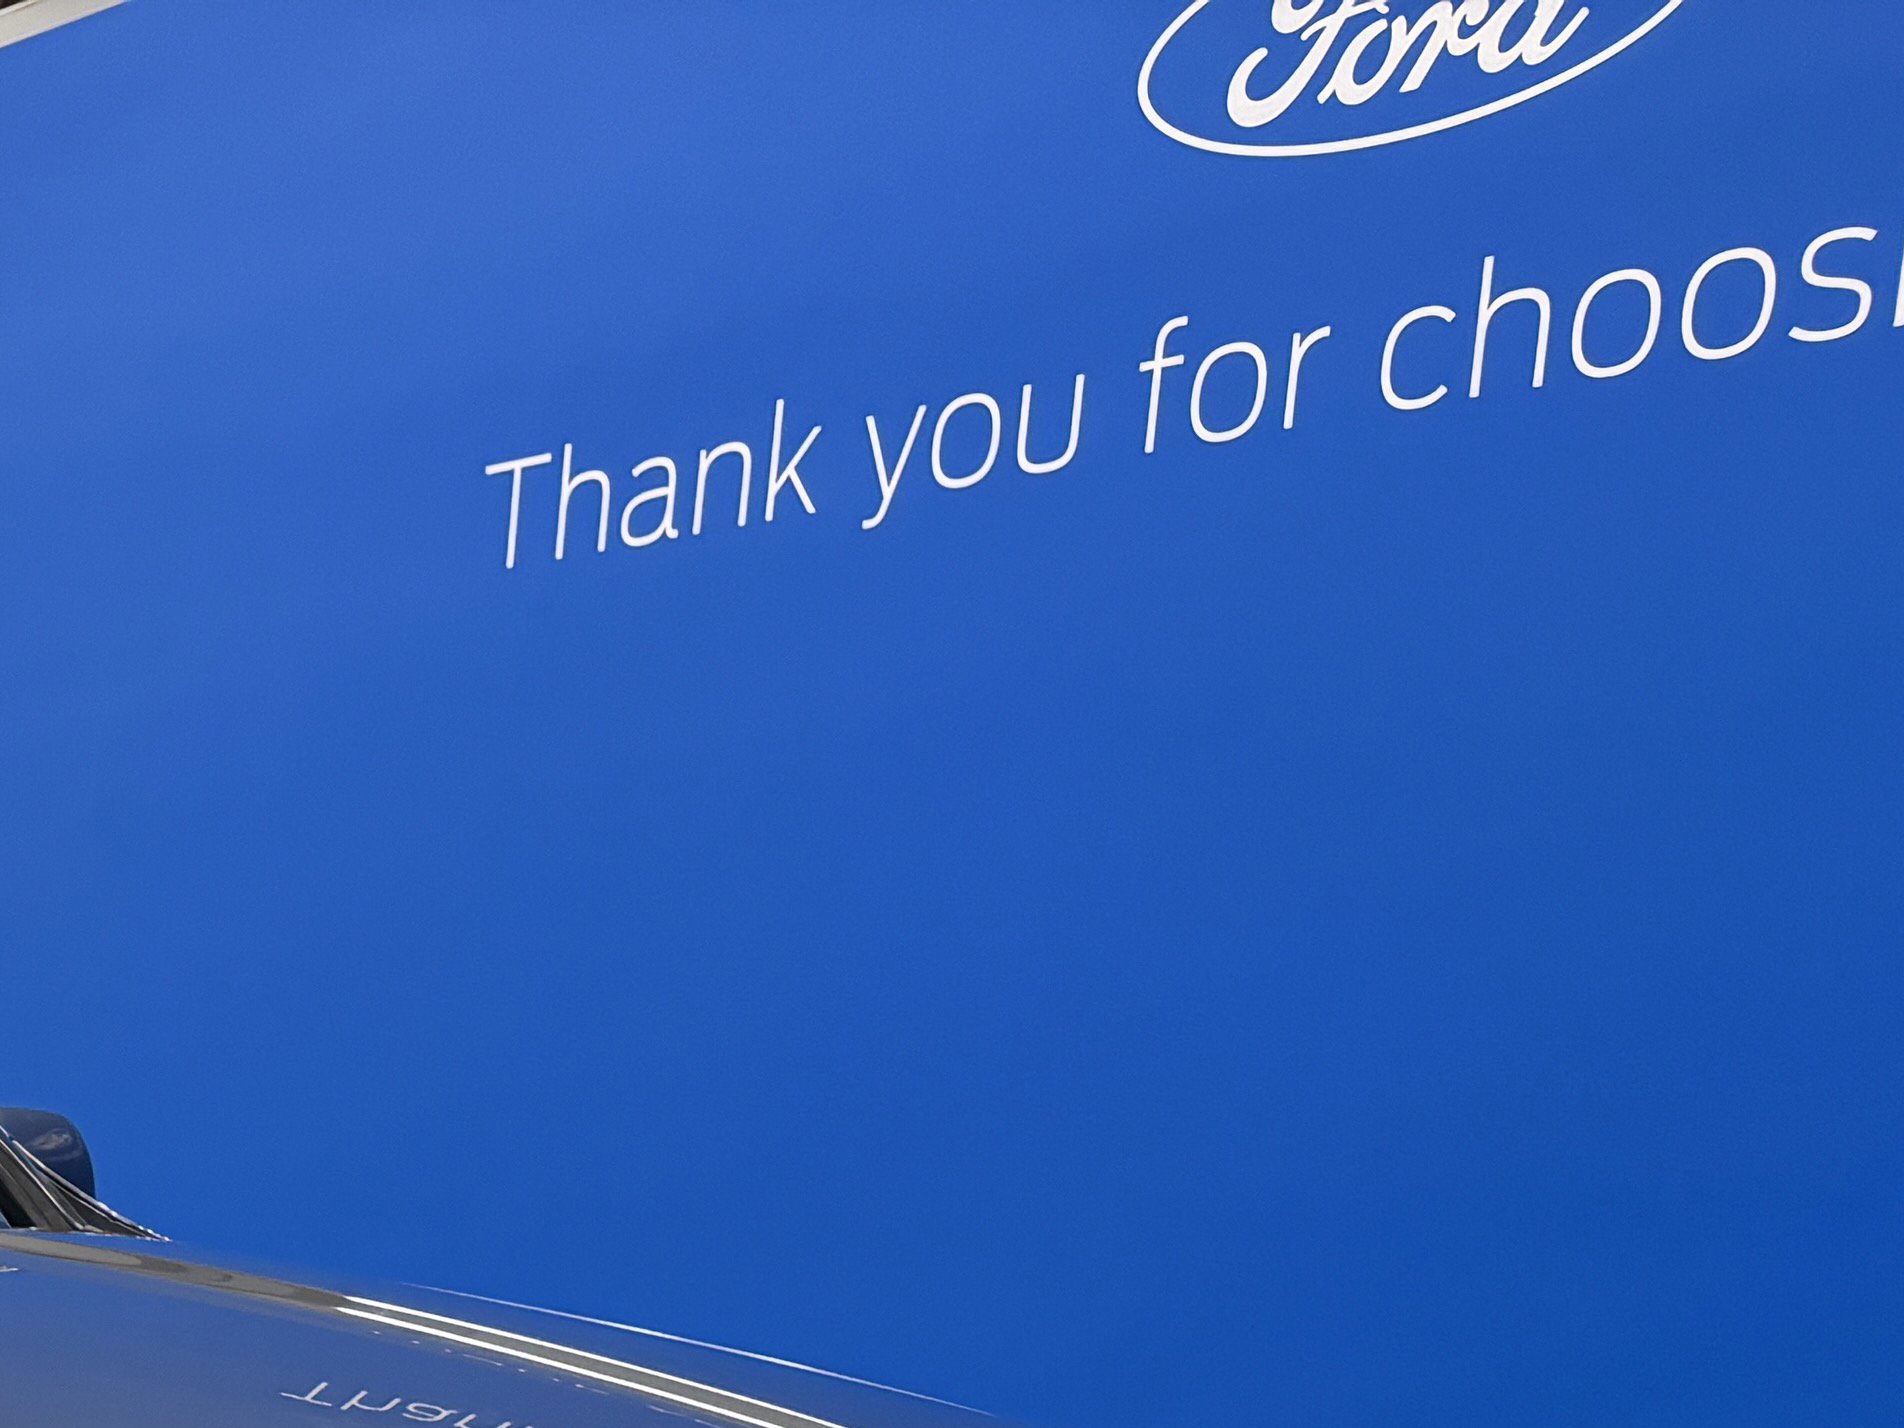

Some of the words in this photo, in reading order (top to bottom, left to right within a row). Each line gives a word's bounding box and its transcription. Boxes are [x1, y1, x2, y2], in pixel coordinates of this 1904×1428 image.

[486, 399, 821, 568] Thank
[862, 374, 1084, 529] you
[1140, 316, 1330, 453] for
